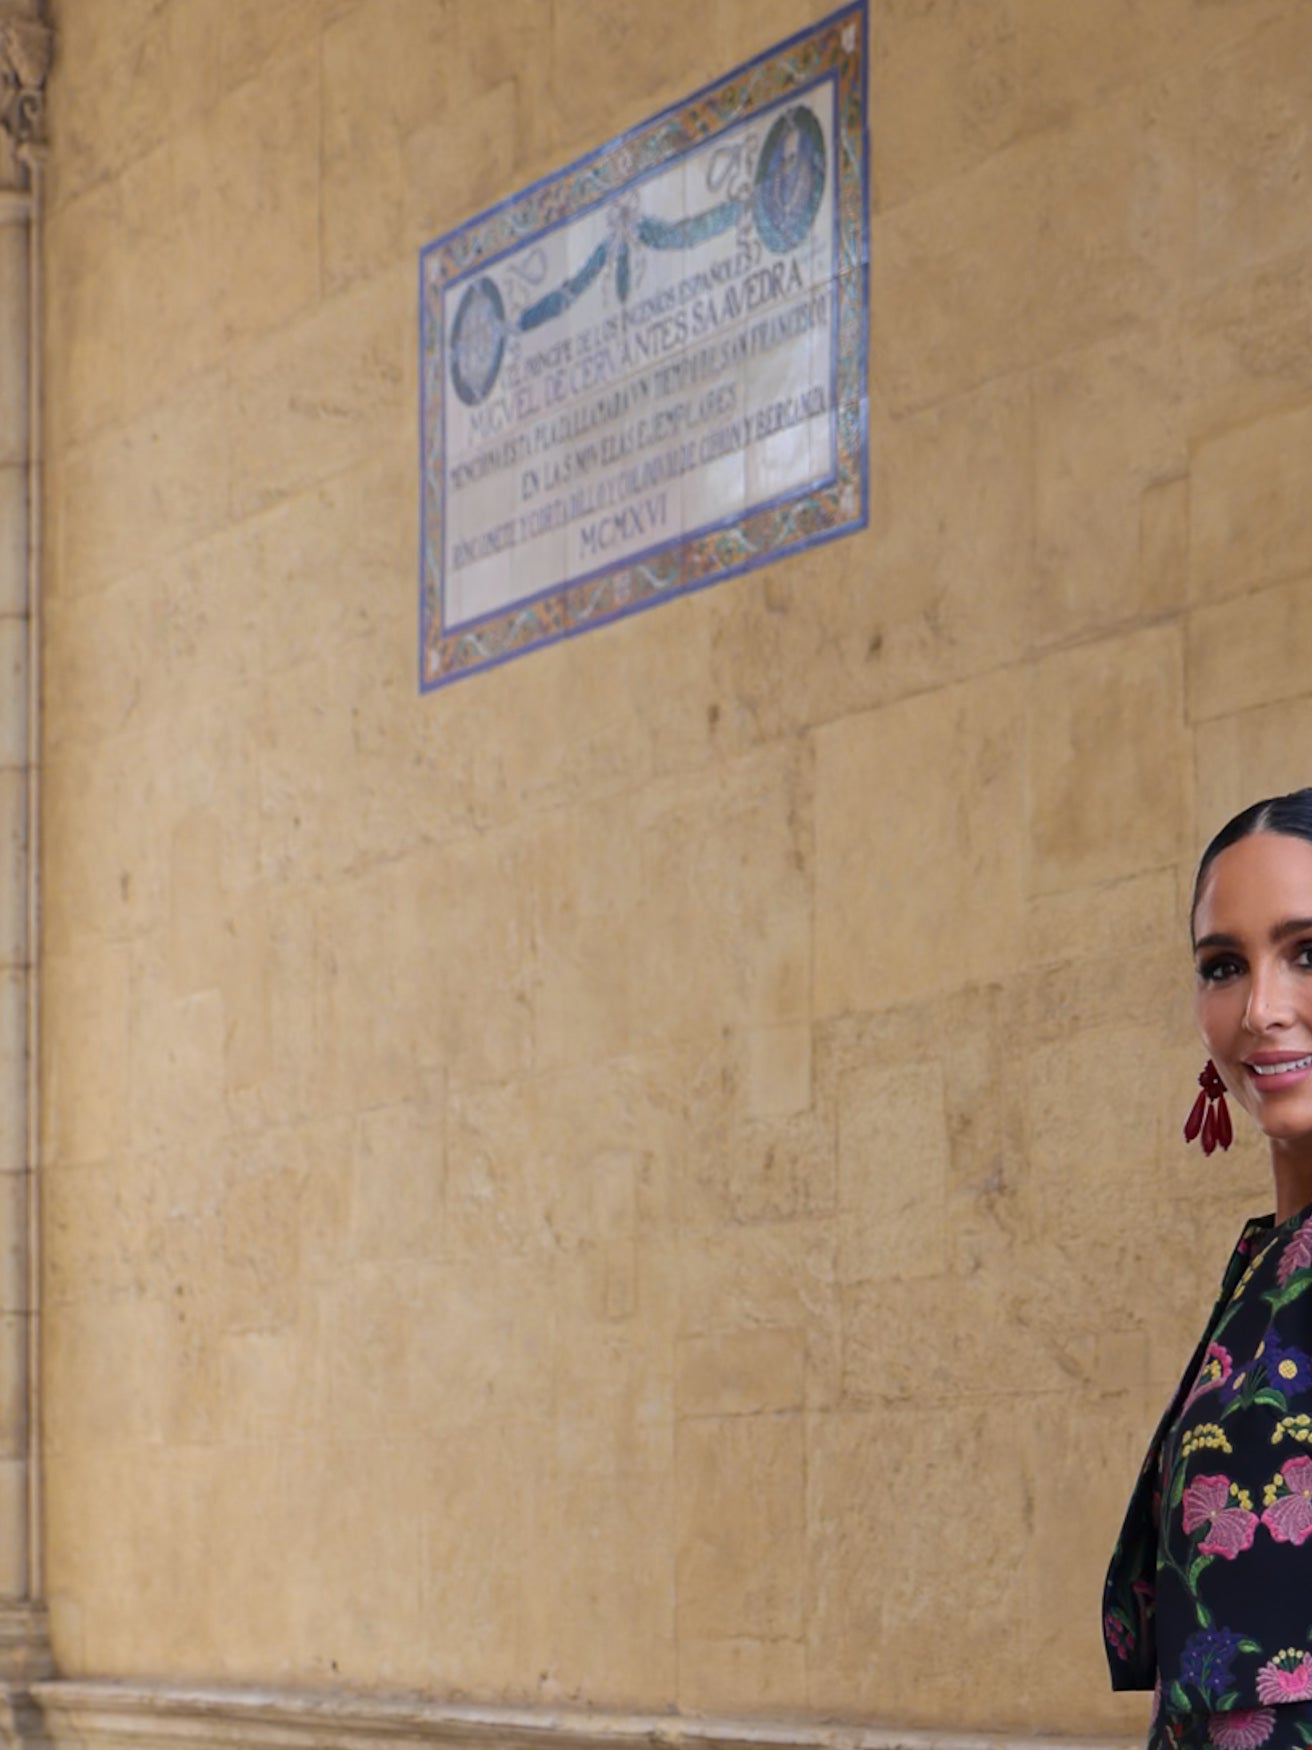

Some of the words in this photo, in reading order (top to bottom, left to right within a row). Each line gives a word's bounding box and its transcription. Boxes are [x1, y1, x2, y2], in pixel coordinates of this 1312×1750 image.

[570, 308, 690, 398] CERVANTES
[692, 252, 802, 340] SAAVEDRA
[581, 492, 668, 560] MCMXVI
